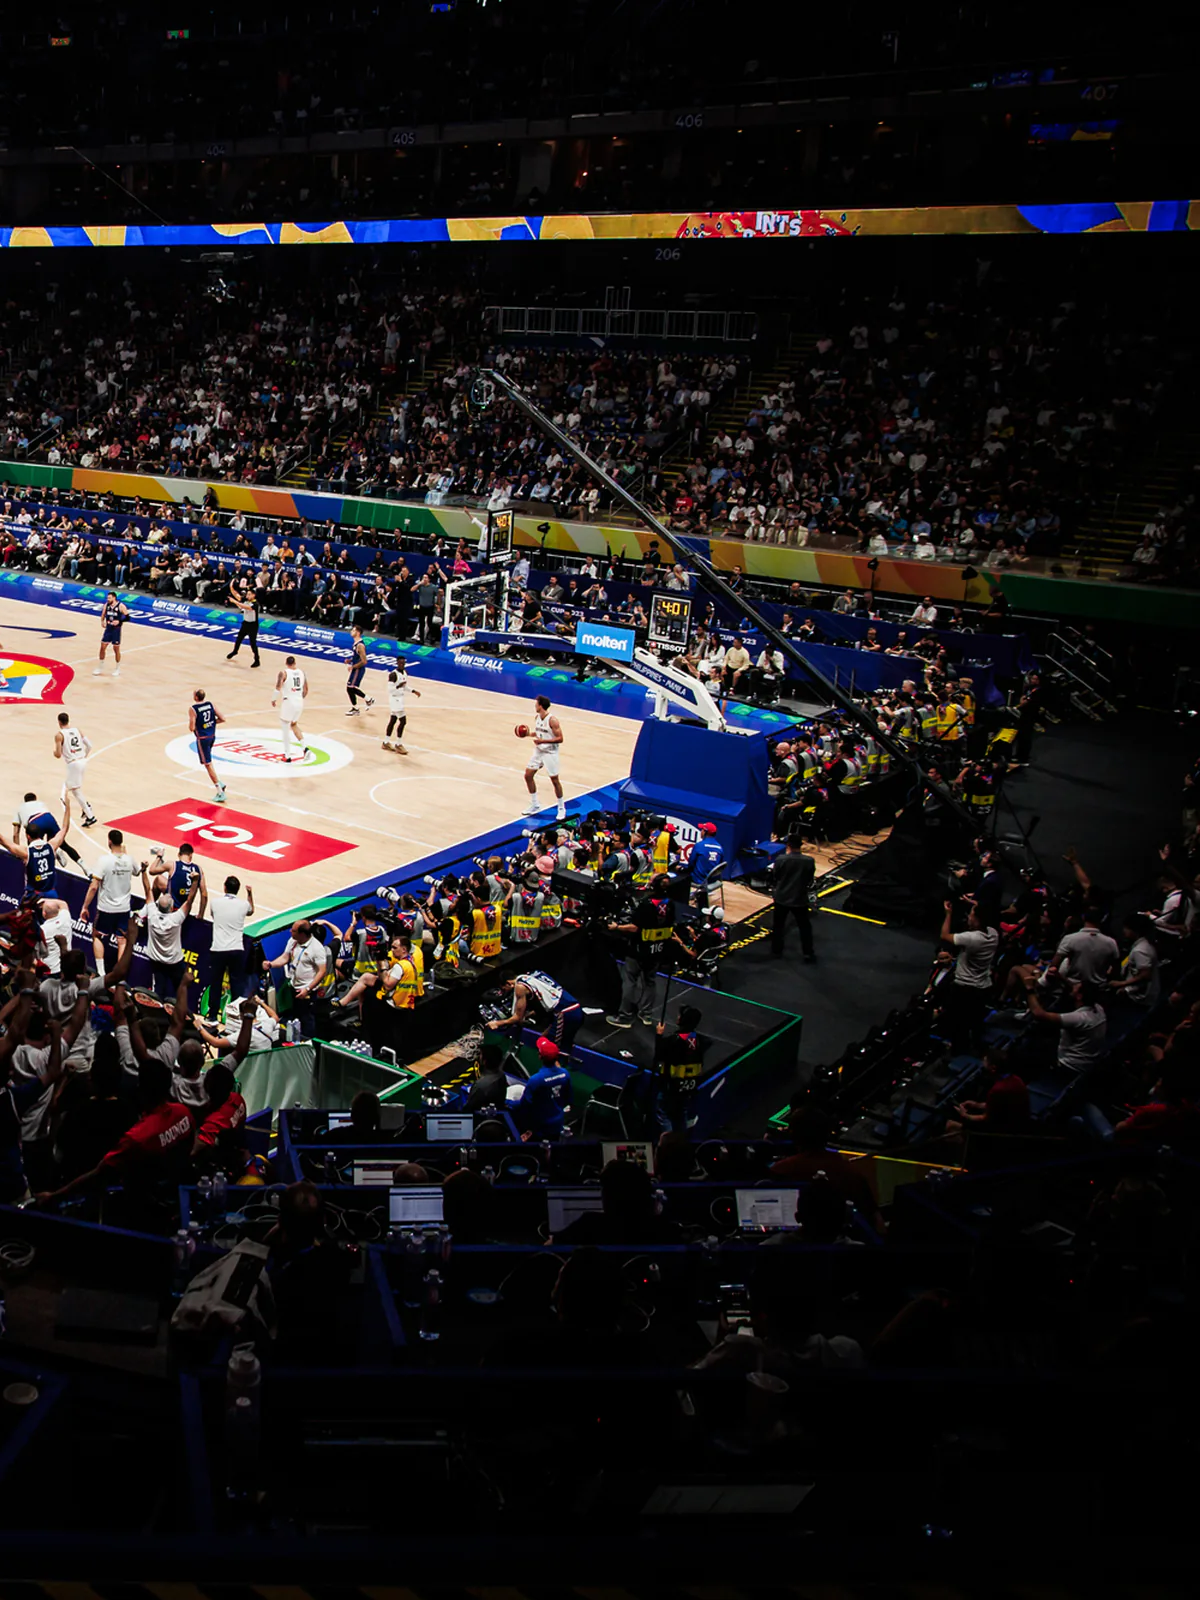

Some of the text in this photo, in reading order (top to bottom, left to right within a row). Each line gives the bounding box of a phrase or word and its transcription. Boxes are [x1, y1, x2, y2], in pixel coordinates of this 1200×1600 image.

[675, 114, 703, 128] 406
[393, 132, 415, 145] 405
[655, 248, 681, 261] 206
[175, 604, 190, 614] ALL
[551, 606, 565, 614] CUP
[662, 600, 688, 616] 4:01
[150, 615, 225, 633] WORLD
[582, 633, 627, 651] molten
[657, 643, 687, 653] TISSOT
[455, 652, 504, 670] WIN FOR ALL
[293, 677, 300, 687] 10
[630, 661, 687, 696] PHILIPPINES MANILA
[203, 710, 211, 722] 27
[70, 736, 80, 747] 42
[173, 812, 291, 860] TCL
[38, 858, 49, 873] 33
[650, 942, 664, 954] 116
